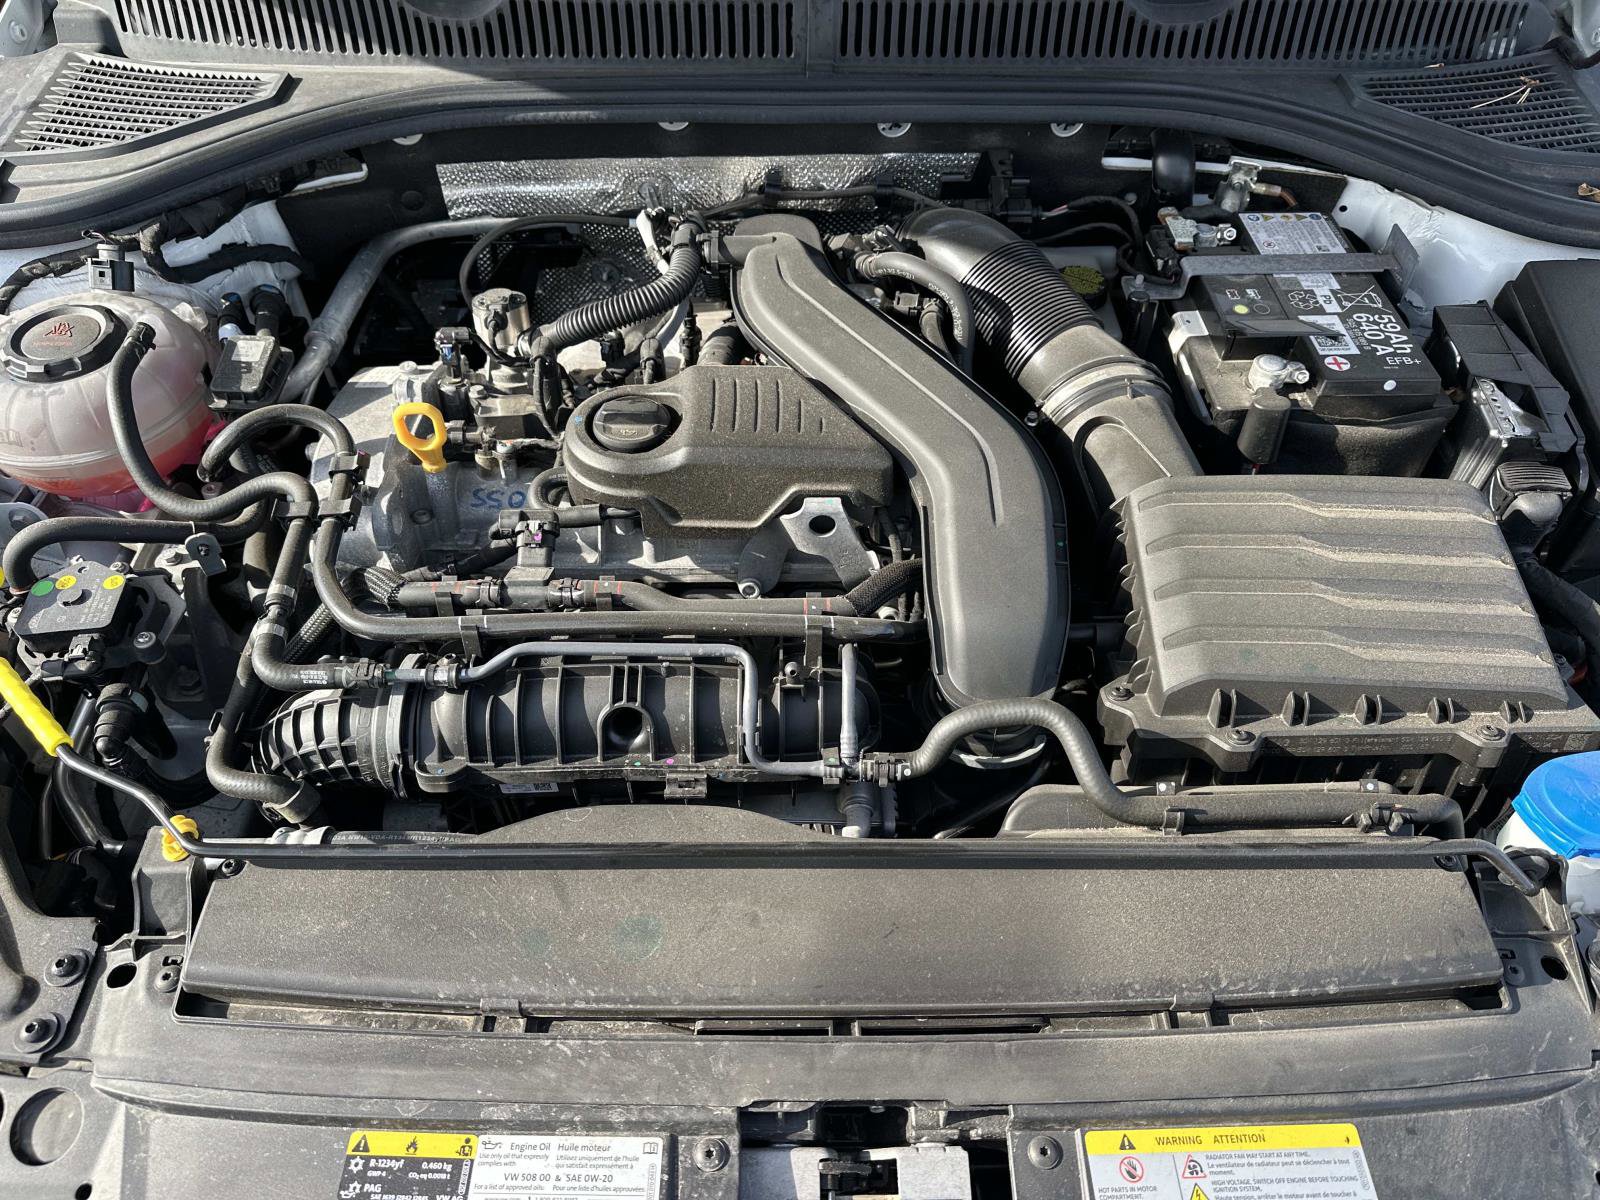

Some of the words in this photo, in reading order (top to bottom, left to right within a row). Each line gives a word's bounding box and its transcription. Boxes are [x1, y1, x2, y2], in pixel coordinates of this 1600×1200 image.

[1322, 294, 1332, 304] Pb
[1353, 313, 1385, 340] 640
[1370, 344, 1394, 356] A
[1374, 314, 1413, 354] 59Ah
[1155, 1136, 1202, 1146] WARNING
[1214, 1134, 1266, 1144] ATTENTION
[510, 1144, 538, 1152] Engine
[370, 1159, 405, 1170] R-1234yf
[443, 1162, 452, 1172] kg
[521, 1173, 536, 1181] 508
[539, 1174, 550, 1182] 00
[566, 1174, 582, 1182] SAE
[585, 1174, 613, 1183] 0W-20
[364, 1184, 382, 1192] PAG
